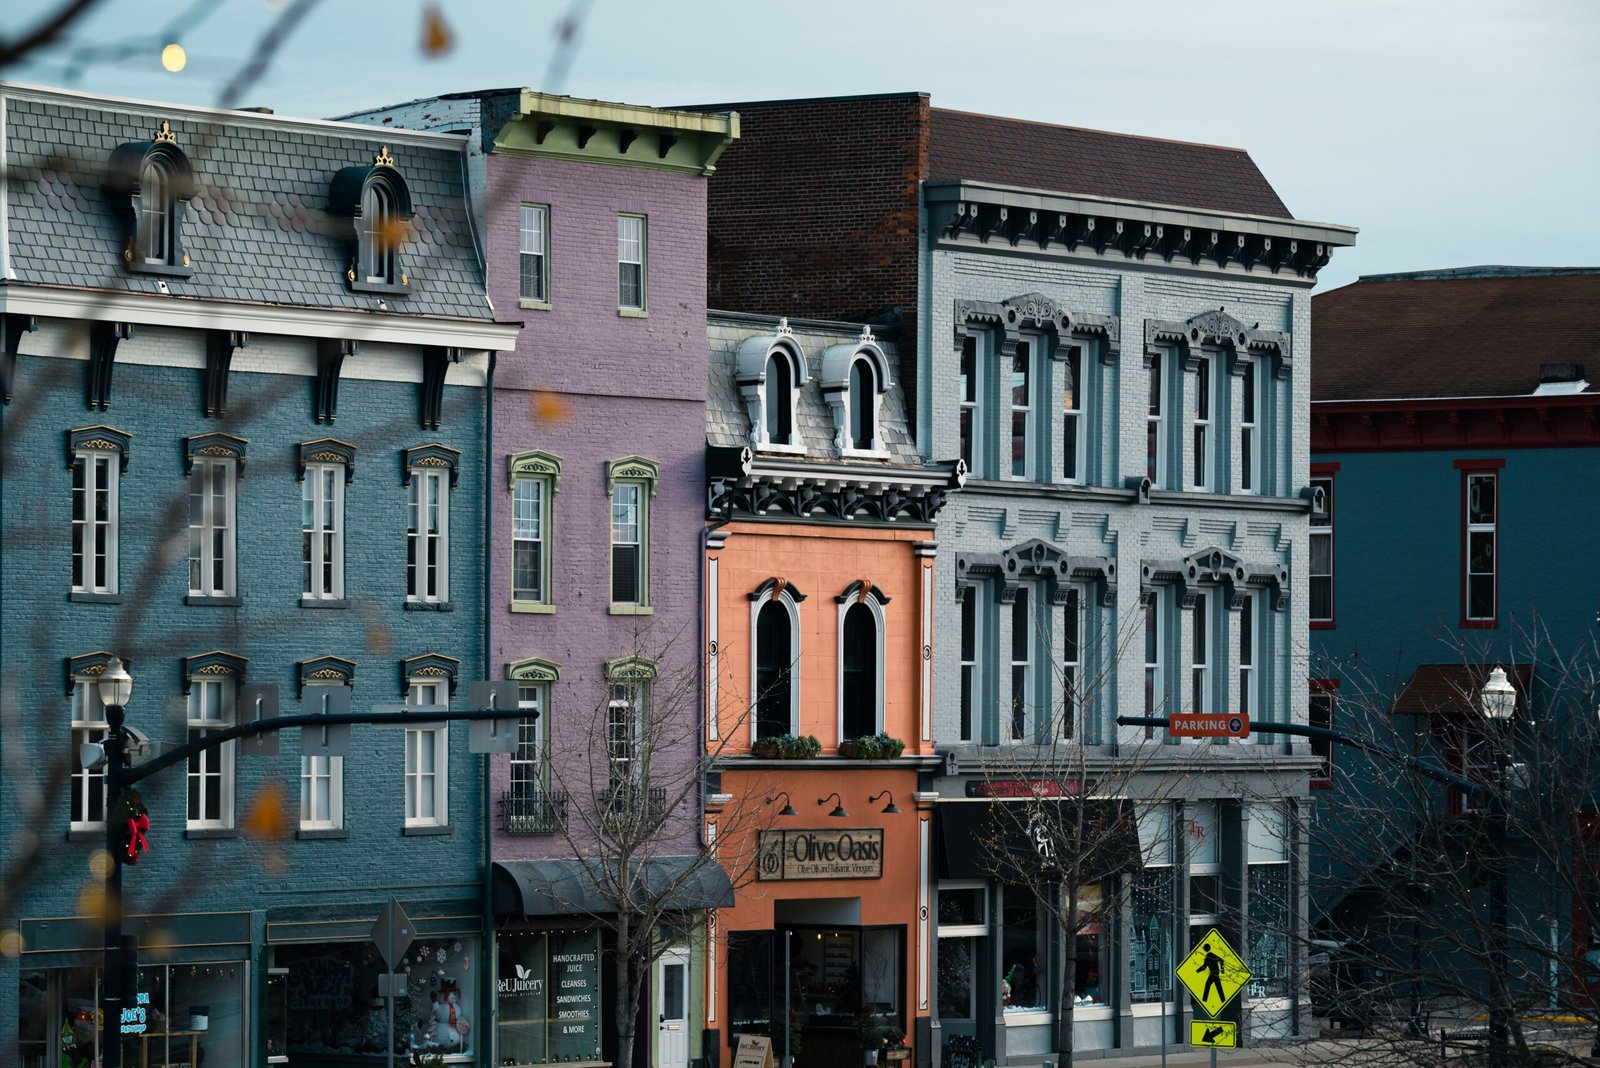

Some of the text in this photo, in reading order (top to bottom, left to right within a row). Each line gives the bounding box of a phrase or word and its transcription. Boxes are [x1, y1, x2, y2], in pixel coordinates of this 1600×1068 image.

[1174, 720, 1227, 731] PARKING
[794, 833, 880, 862] Olive Oasis
[797, 864, 811, 873] Olive
[553, 954, 595, 962] HANDCRAFTED
[566, 964, 583, 973] JUICE
[512, 978, 544, 995] Juicery
[561, 980, 587, 988] CLEANSES
[556, 994, 591, 1004] SANDWICHES
[120, 1007, 147, 1023] JOE'S
[558, 1010, 589, 1019] SMOOTHIES
[563, 1025, 585, 1034] & MORE
